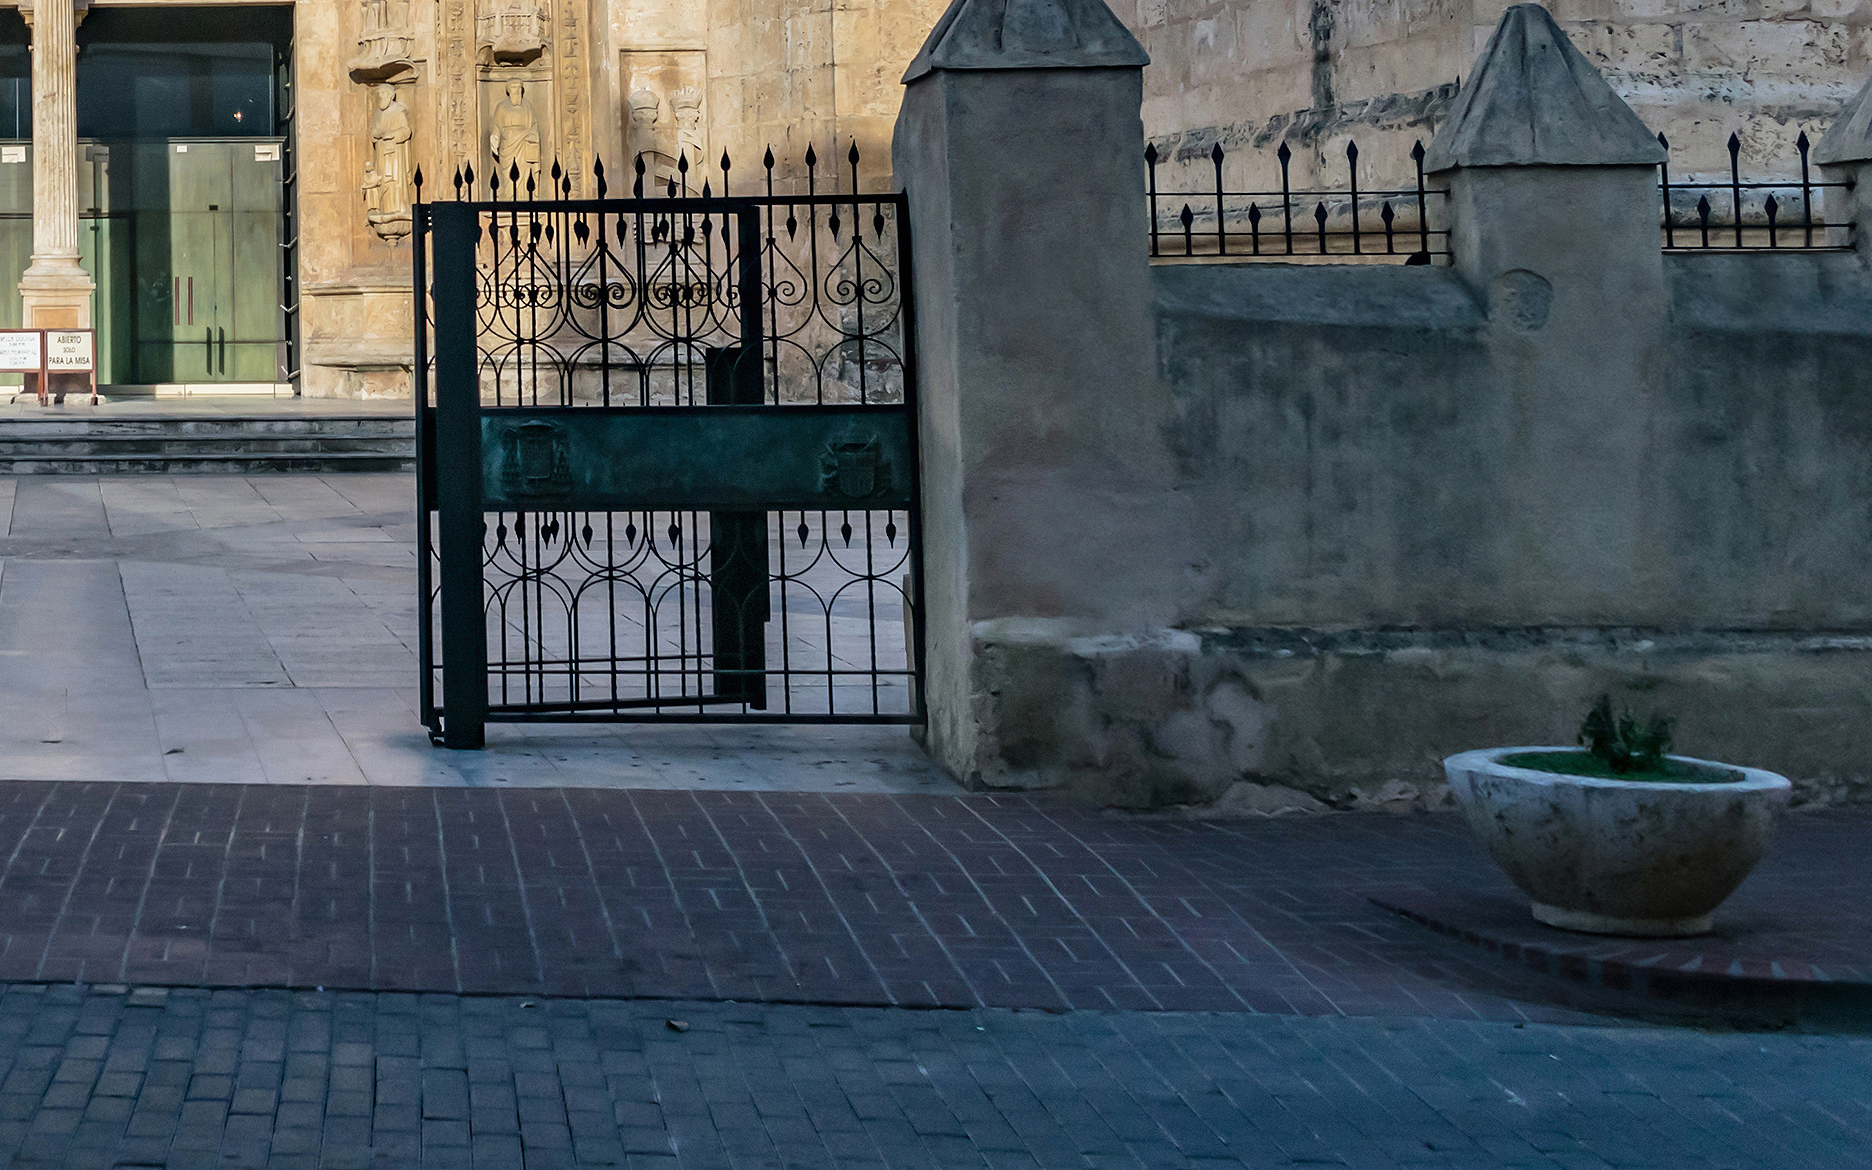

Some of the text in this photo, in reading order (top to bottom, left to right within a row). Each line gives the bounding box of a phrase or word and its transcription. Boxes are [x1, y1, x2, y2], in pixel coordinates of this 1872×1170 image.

[57, 335, 81, 343] ABIERTO
[49, 356, 90, 364] PARA LA MISA
